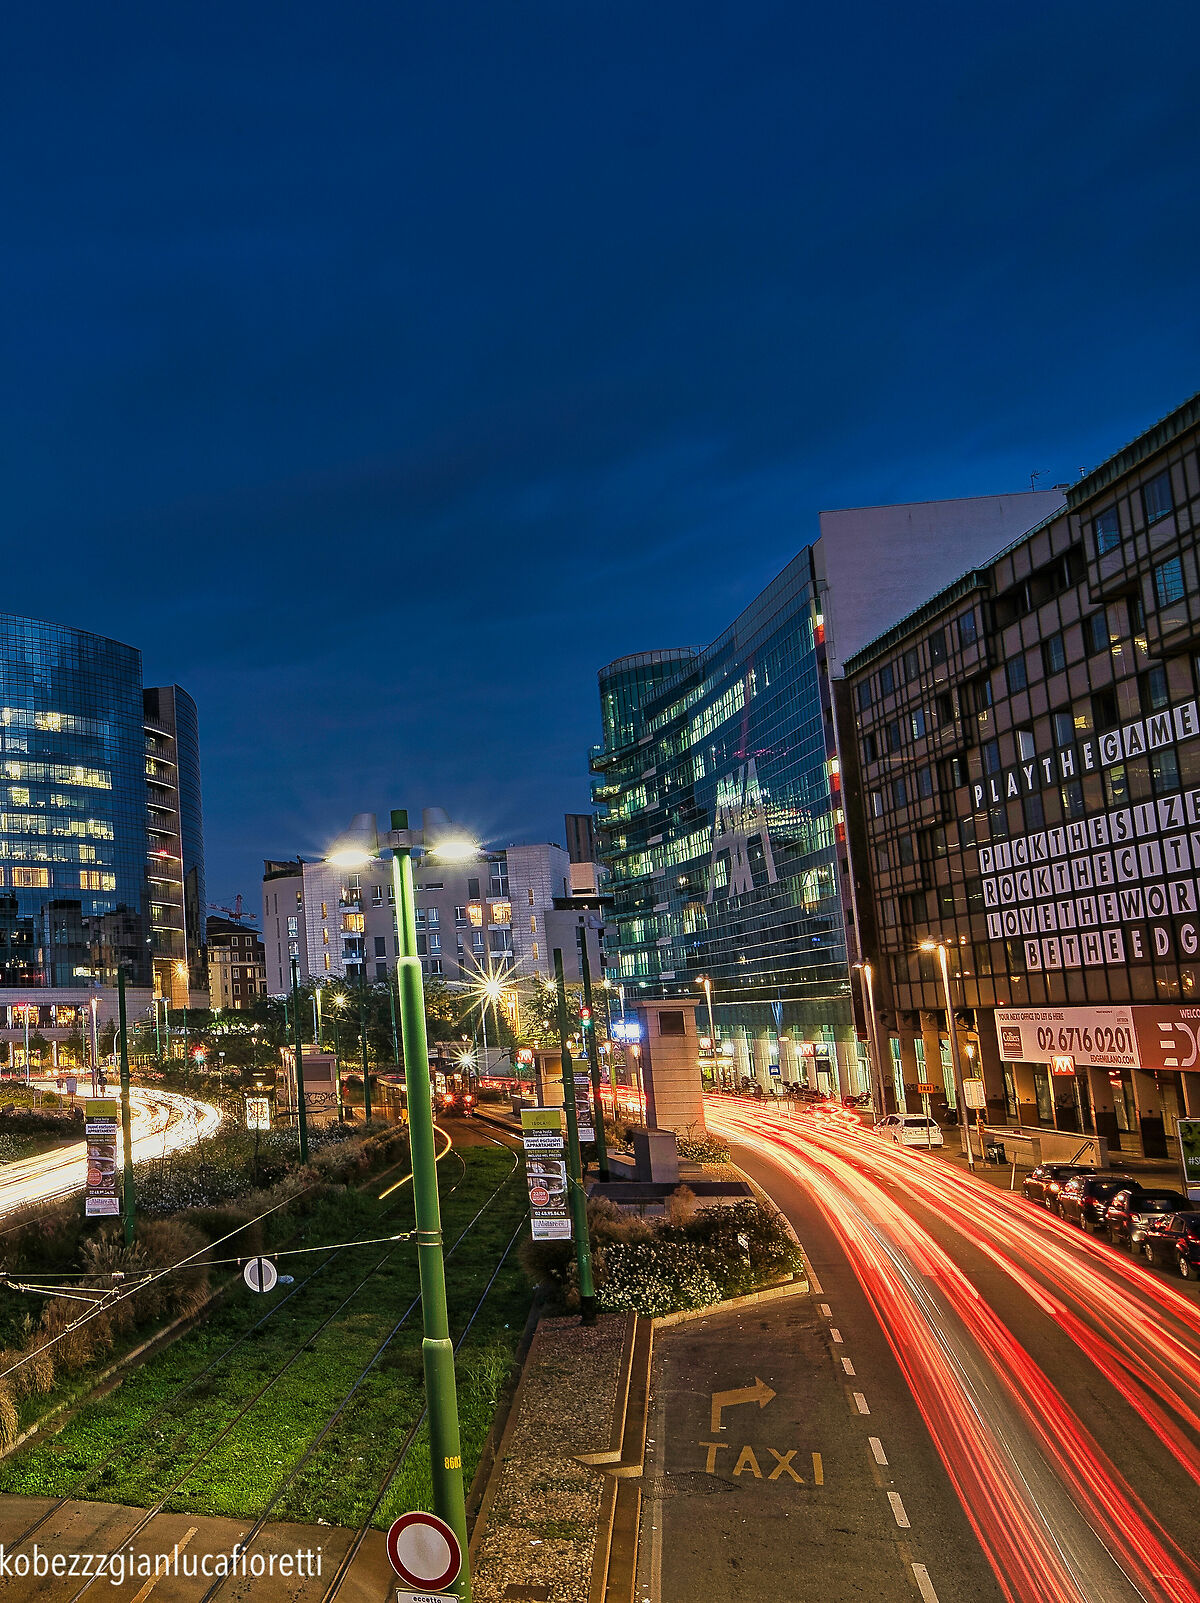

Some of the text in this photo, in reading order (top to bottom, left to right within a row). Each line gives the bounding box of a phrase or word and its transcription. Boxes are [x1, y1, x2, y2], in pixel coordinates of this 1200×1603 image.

[1010, 1013, 1020, 1021] NEXT
[1021, 1013, 1035, 1021] OFFICE
[1037, 1027, 1134, 1053] 02 6716 0201
[699, 1441, 825, 1486] TAXI
